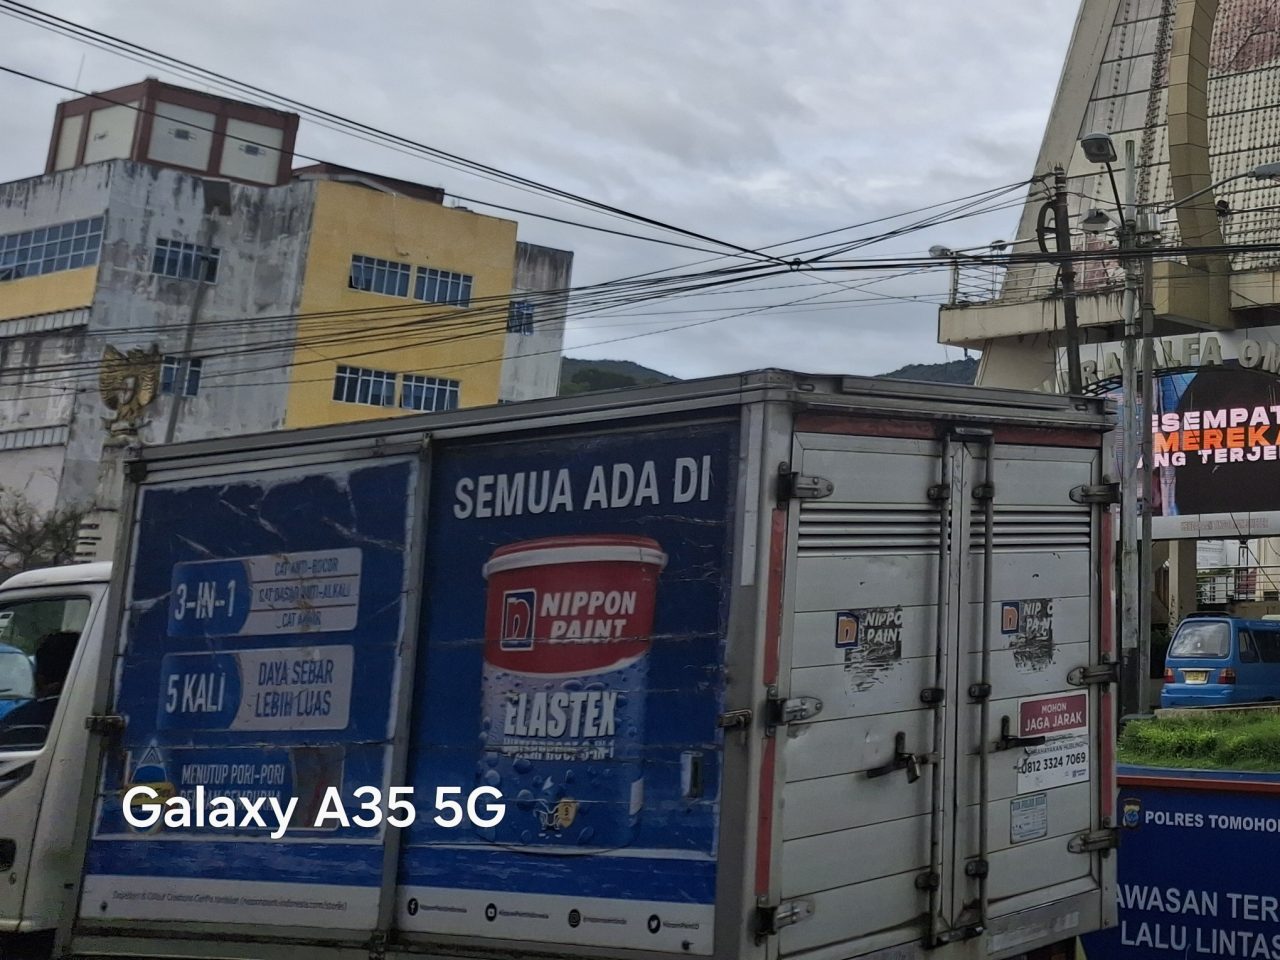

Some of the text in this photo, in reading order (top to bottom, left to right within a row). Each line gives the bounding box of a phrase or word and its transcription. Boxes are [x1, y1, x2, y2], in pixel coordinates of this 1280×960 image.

[453, 455, 711, 520] SEMUA ADA DI
[174, 580, 236, 620] 3-IN-1
[540, 591, 637, 617] NIPPON
[1023, 602, 1054, 615] NIPO
[549, 619, 627, 643] PAINT
[257, 658, 334, 686] DAYA SEBAR
[165, 672, 226, 713] 5 KALI
[254, 690, 332, 718] LEBIH LUAS
[504, 691, 618, 738] ELASTEX
[1041, 702, 1067, 714] MOHON
[1025, 711, 1082, 732] JAGA JARAK
[181, 763, 285, 785] MENUTUP PORI-PORI
[1021, 752, 1086, 774] 0812 3324 7069
[1145, 810, 1204, 828] POLRES
[1121, 920, 1187, 951] LALU
